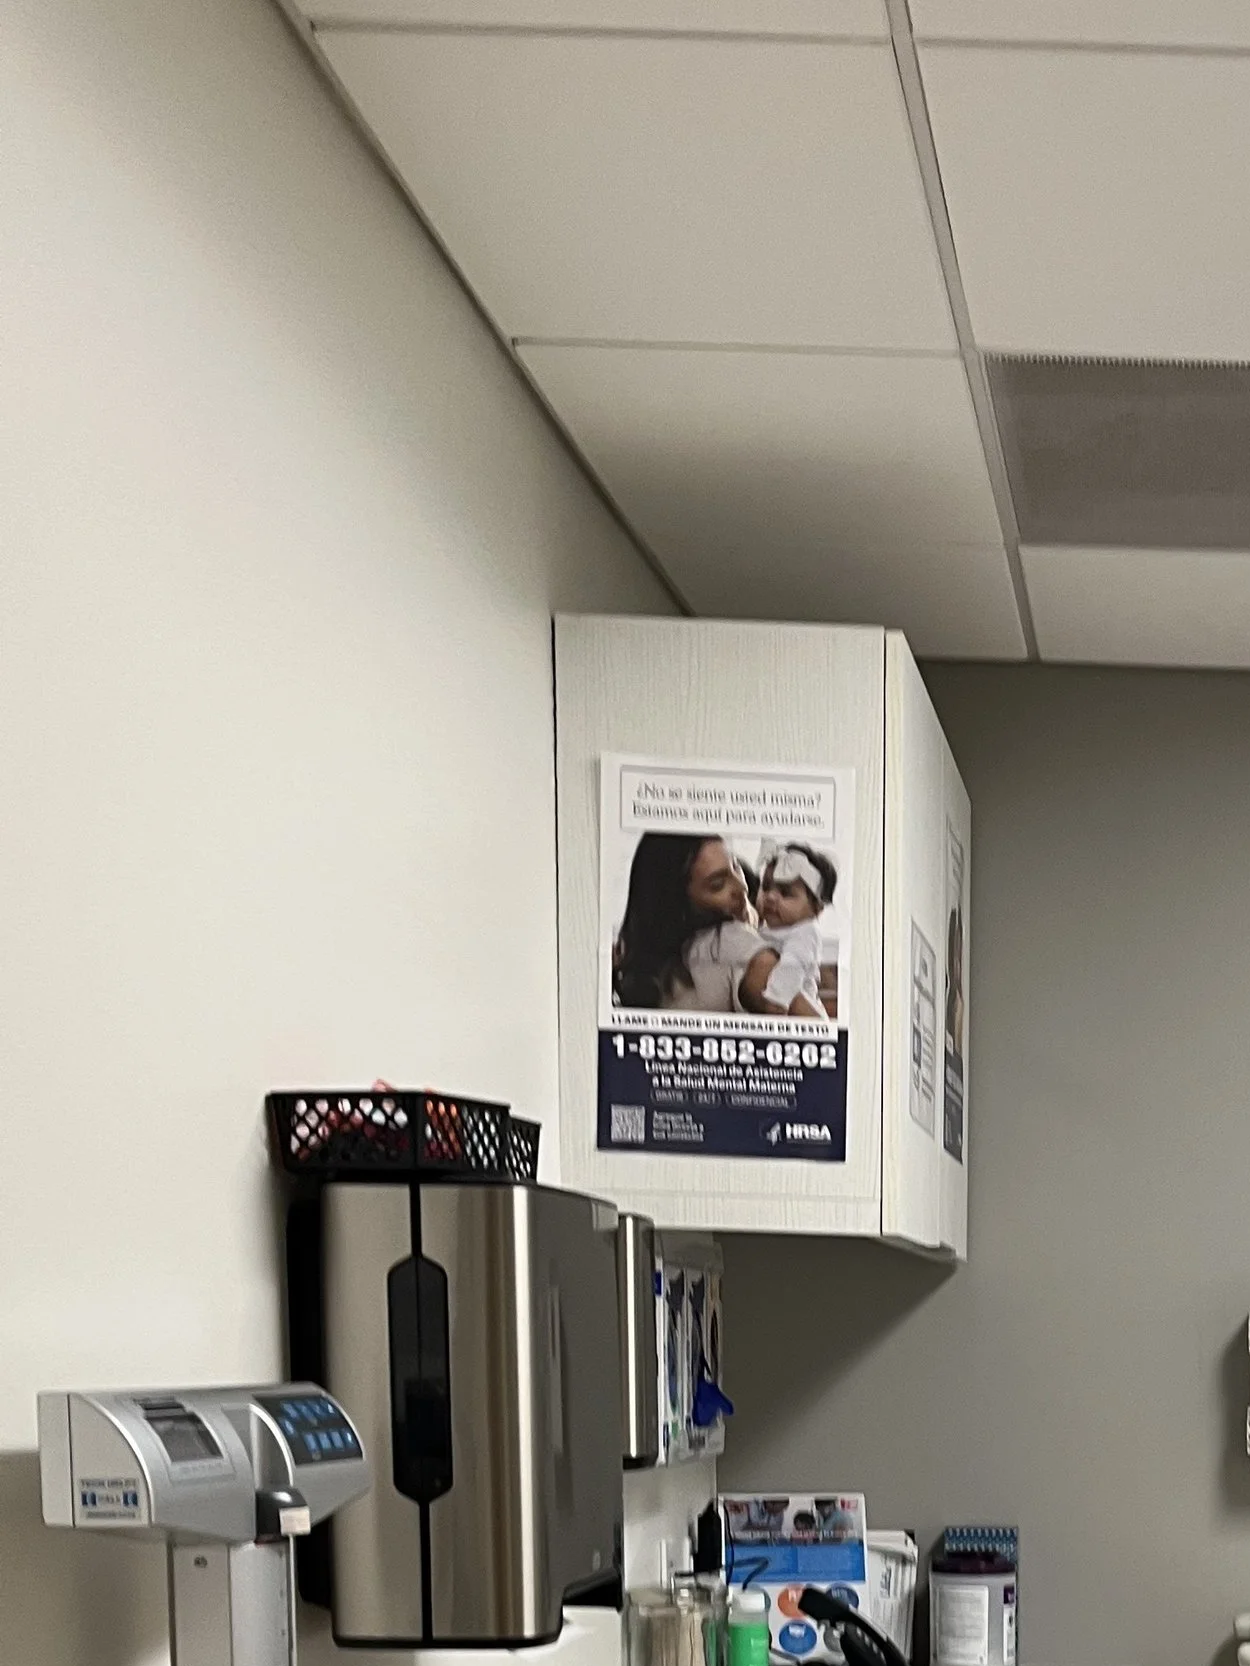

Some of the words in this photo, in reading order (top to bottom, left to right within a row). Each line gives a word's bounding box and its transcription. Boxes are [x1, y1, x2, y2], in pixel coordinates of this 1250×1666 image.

[637, 783, 664, 799] ¿No
[668, 785, 682, 800] se
[686, 785, 726, 802] siente
[730, 788, 767, 806] usted
[770, 791, 822, 810] misma?
[633, 801, 688, 820] Estamos
[725, 808, 757, 826] para
[661, 1016, 700, 1028] MANDE
[704, 1018, 721, 1029] UN
[677, 1060, 727, 1078] Nacional
[728, 1063, 744, 1078] de
[745, 1064, 804, 1082] Asistencia
[661, 1073, 671, 1088] la
[673, 1073, 705, 1090] Salud
[707, 1075, 747, 1092] Mental
[748, 1078, 796, 1095] Materna
[785, 1121, 832, 1142] HRSA
